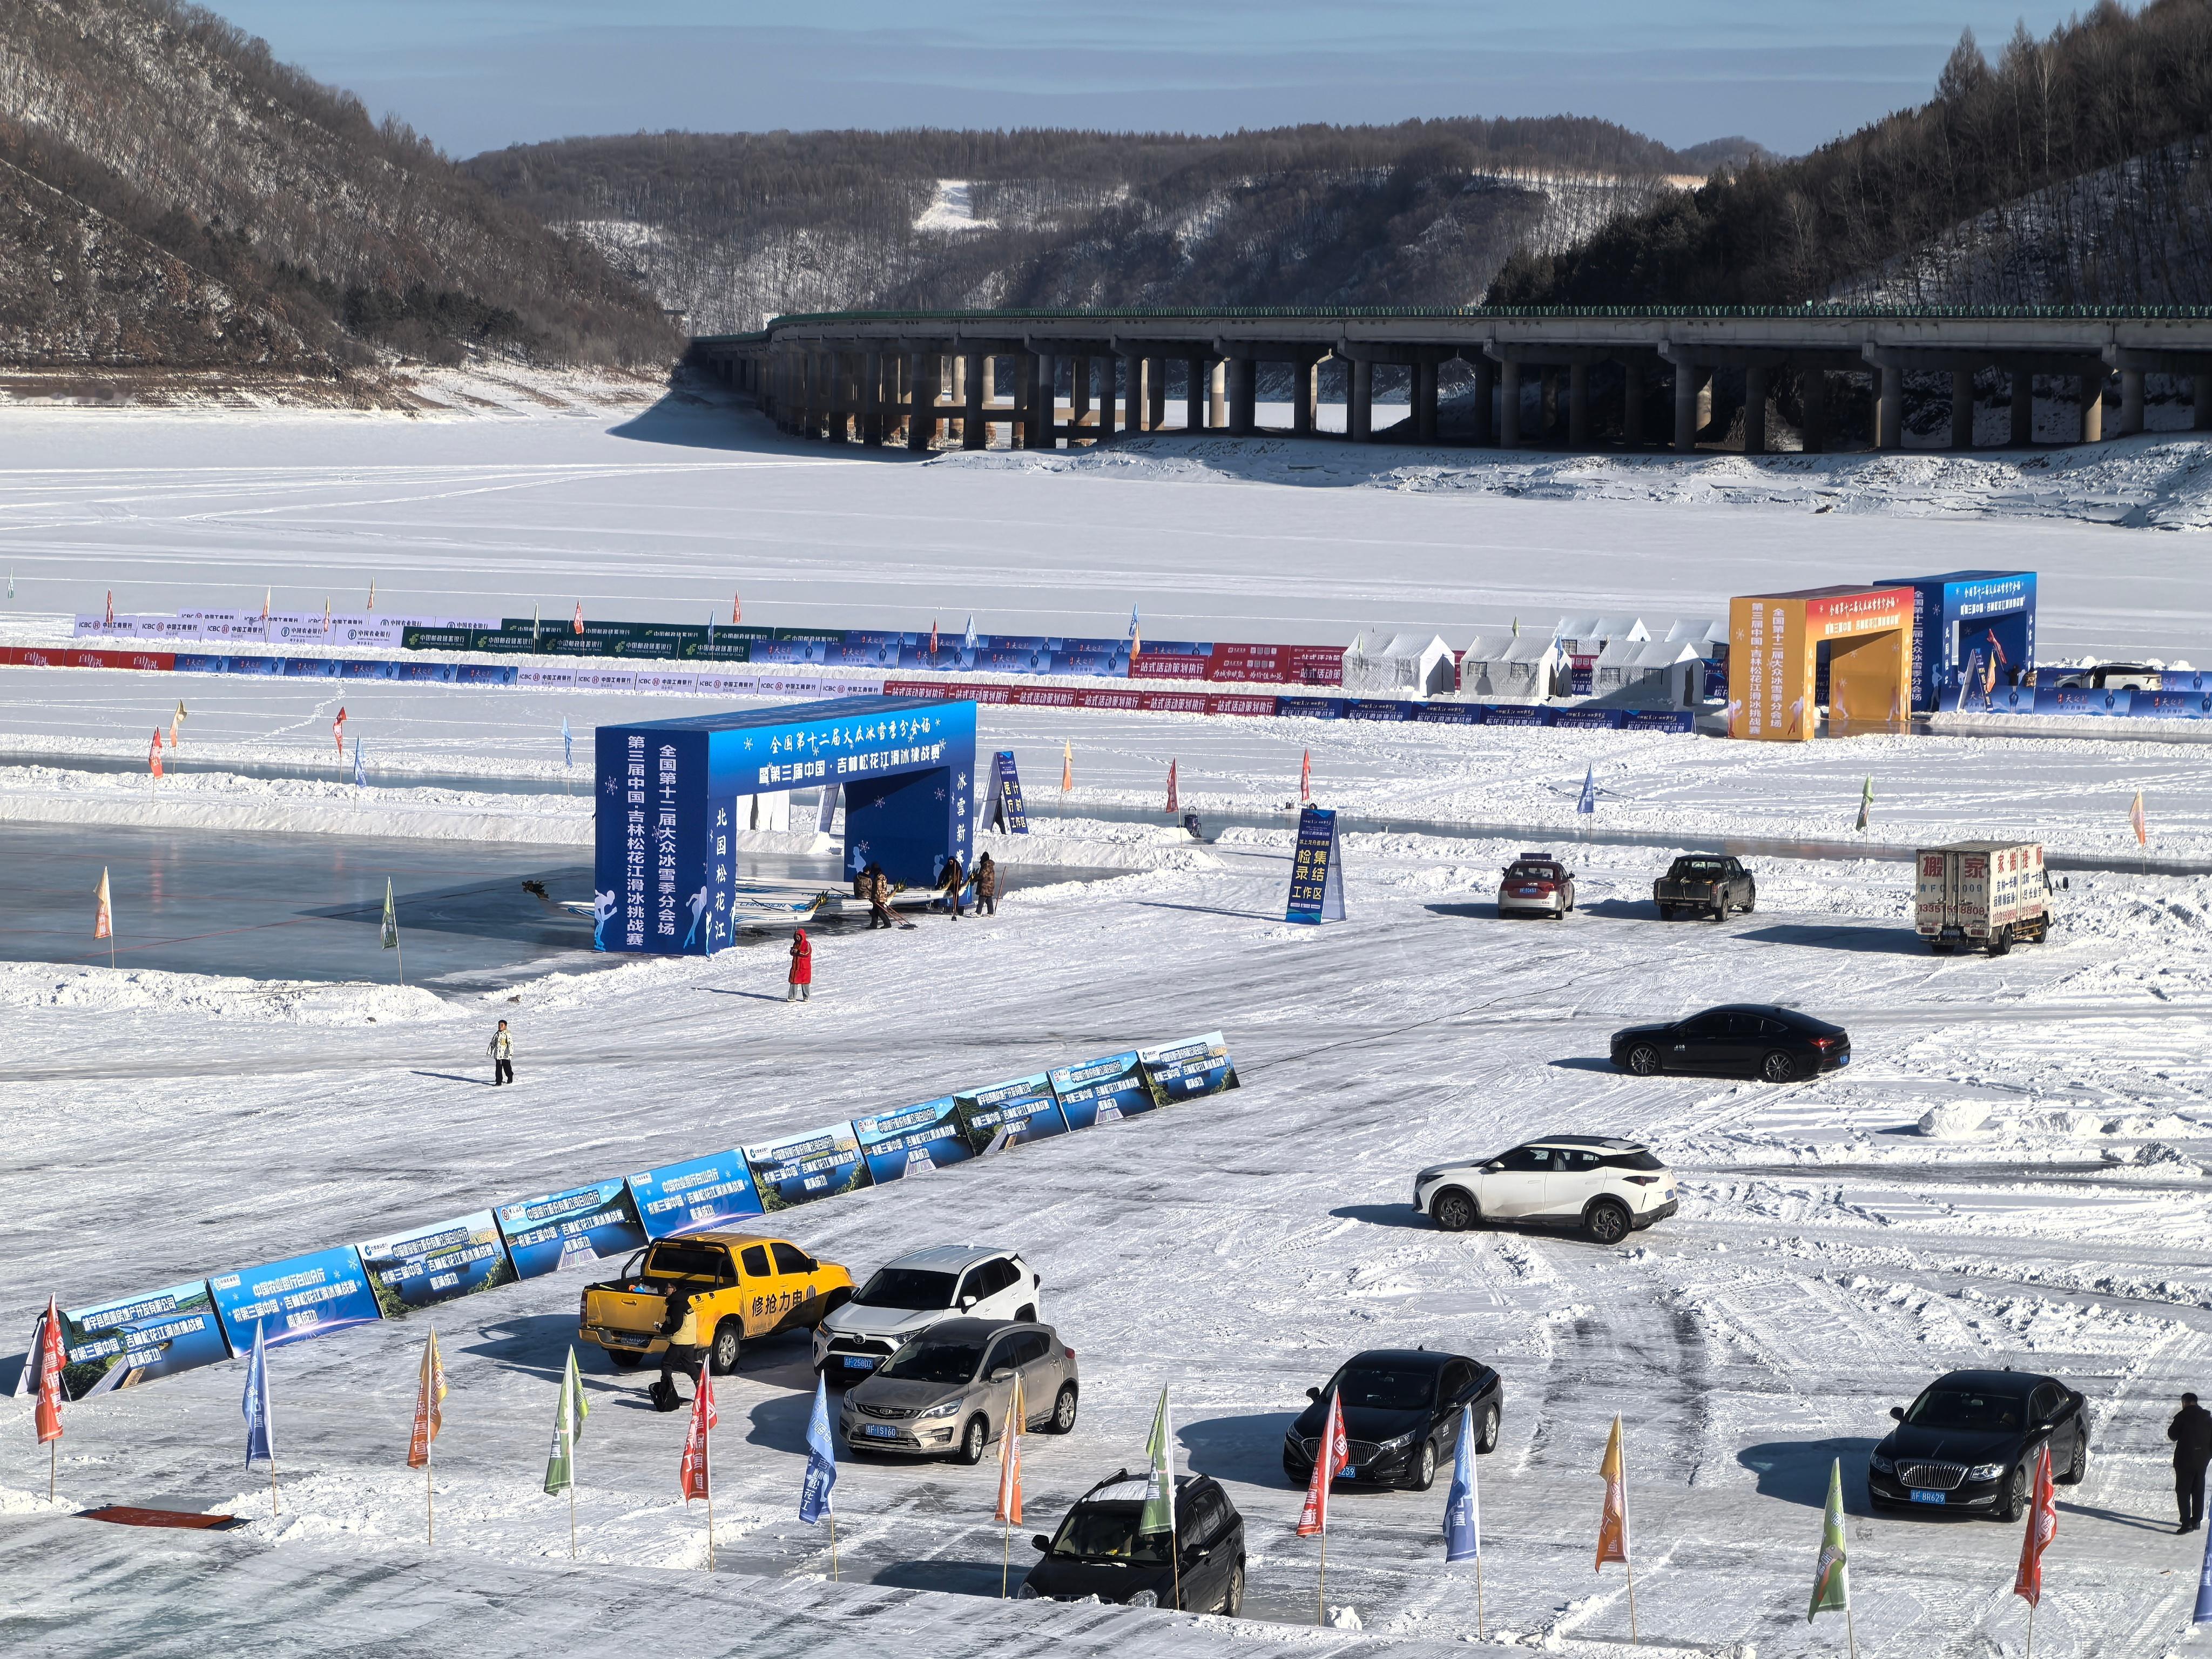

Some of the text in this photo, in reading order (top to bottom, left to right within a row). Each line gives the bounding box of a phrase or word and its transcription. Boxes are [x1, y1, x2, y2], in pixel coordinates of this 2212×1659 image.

[420, 635, 464, 643] 中国邮政储蓄银行
[488, 637, 533, 645] 中国邮政储蓄银行
[557, 639, 602, 648] 中国邮政储蓄银行
[626, 641, 672, 651] 中国邮政储蓄银行
[1134, 662, 1204, 674] 一站式活动策划执行
[542, 674, 571, 682] 中国工商银行
[1014, 691, 1074, 705] 一站式活动策划执行
[1078, 693, 1138, 707] 一站式活动策划执行
[1144, 697, 1205, 711] 一站式活动策划执行
[1211, 699, 1273, 713] 一站式活动策划执行
[770, 717, 930, 754] 全国第十二届大众冰雪季分会场
[759, 744, 940, 784] 暨第三届中国·吉林松花江滑冰挑战赛
[1010, 817, 1027, 828] 工作区
[626, 736, 645, 946] 第三届中国·吉林松花江滑冰挑战赛
[658, 745, 677, 935] 全国第十二届大众冰雪季分会场
[714, 807, 727, 939] 北国松花江
[1292, 886, 1323, 900] 工作区
[527, 1191, 601, 1220] 中国银行股份有限公司白山分行
[393, 1229, 469, 1258] 中国建设银行股份有限公司白山分行
[253, 1267, 326, 1297] 中国农业银行白山分行
[429, 1272, 459, 1291] 圆满成功
[286, 1309, 318, 1329] 圆满成功
[127, 1350, 162, 1368] 圆满成功
